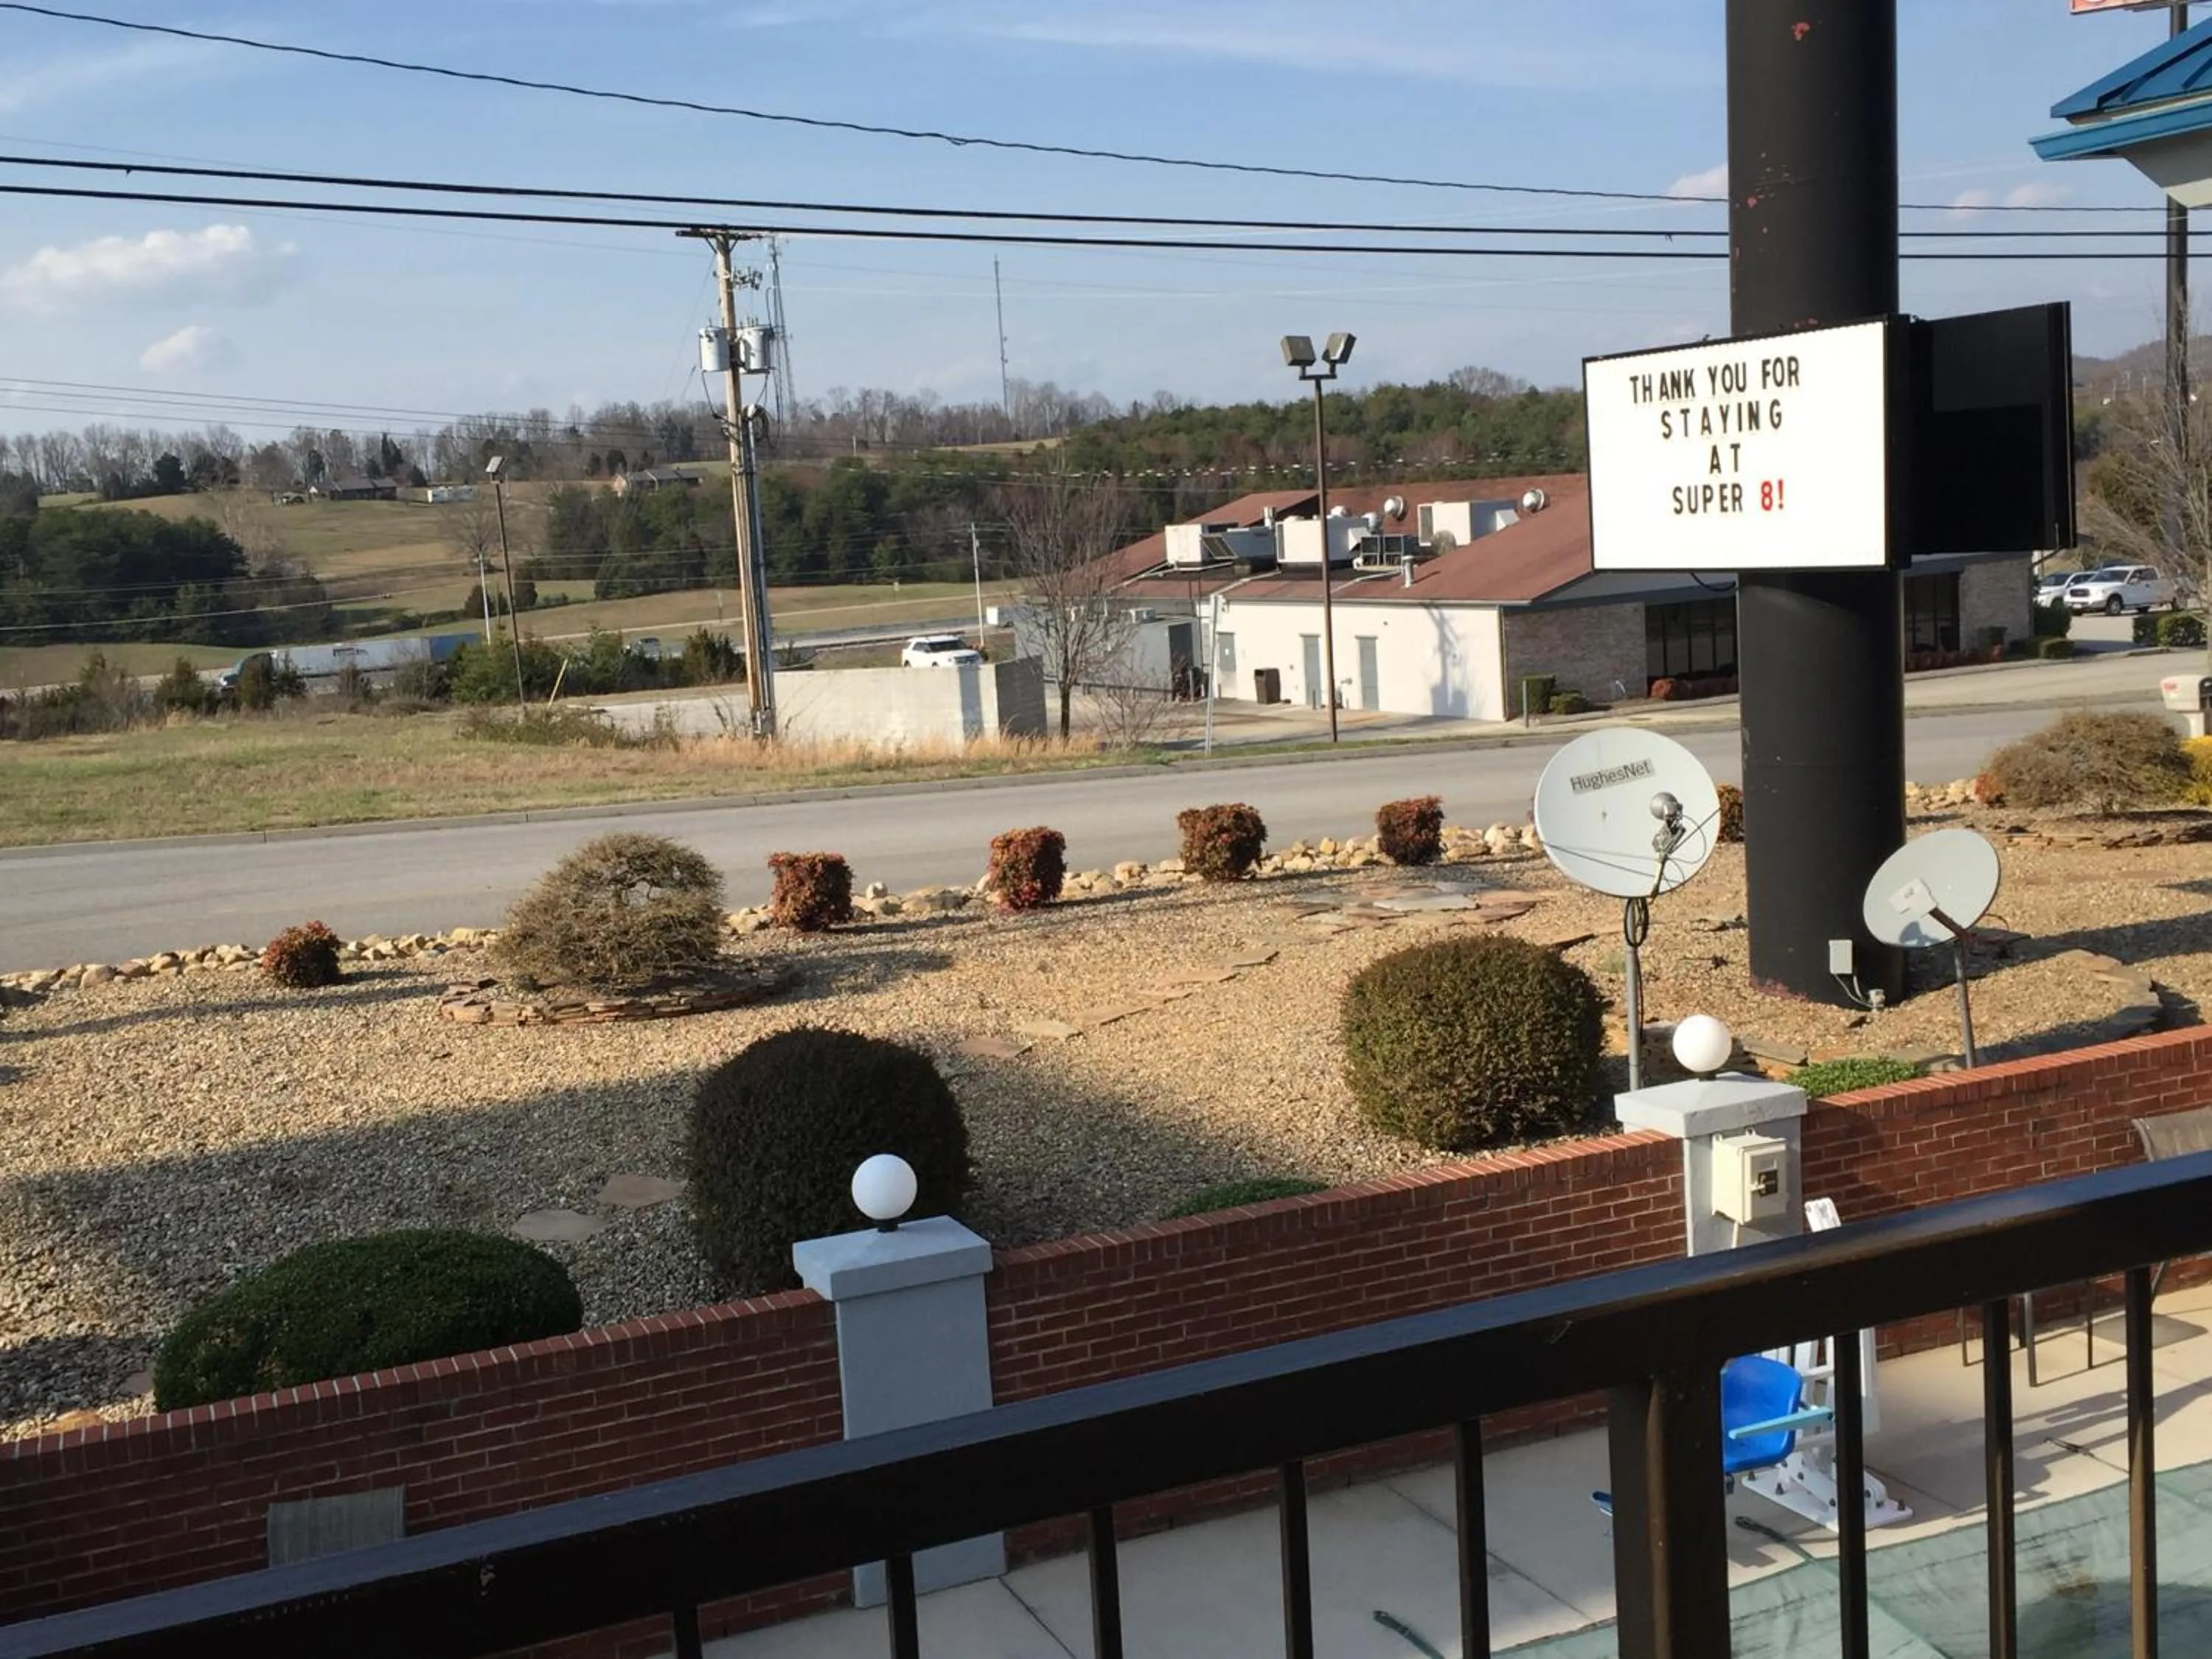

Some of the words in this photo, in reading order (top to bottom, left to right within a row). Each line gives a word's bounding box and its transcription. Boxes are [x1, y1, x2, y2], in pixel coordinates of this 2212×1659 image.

[1629, 368, 1697, 404] THANK
[1707, 361, 1747, 397] YOU
[1761, 355, 1801, 391] FOR
[1660, 398, 1783, 440] STAYING
[1708, 442, 1741, 475] AT
[1672, 483, 1743, 515] SUPER
[1760, 479, 1784, 511] 8!
[1569, 759, 1651, 790] HughesNet
